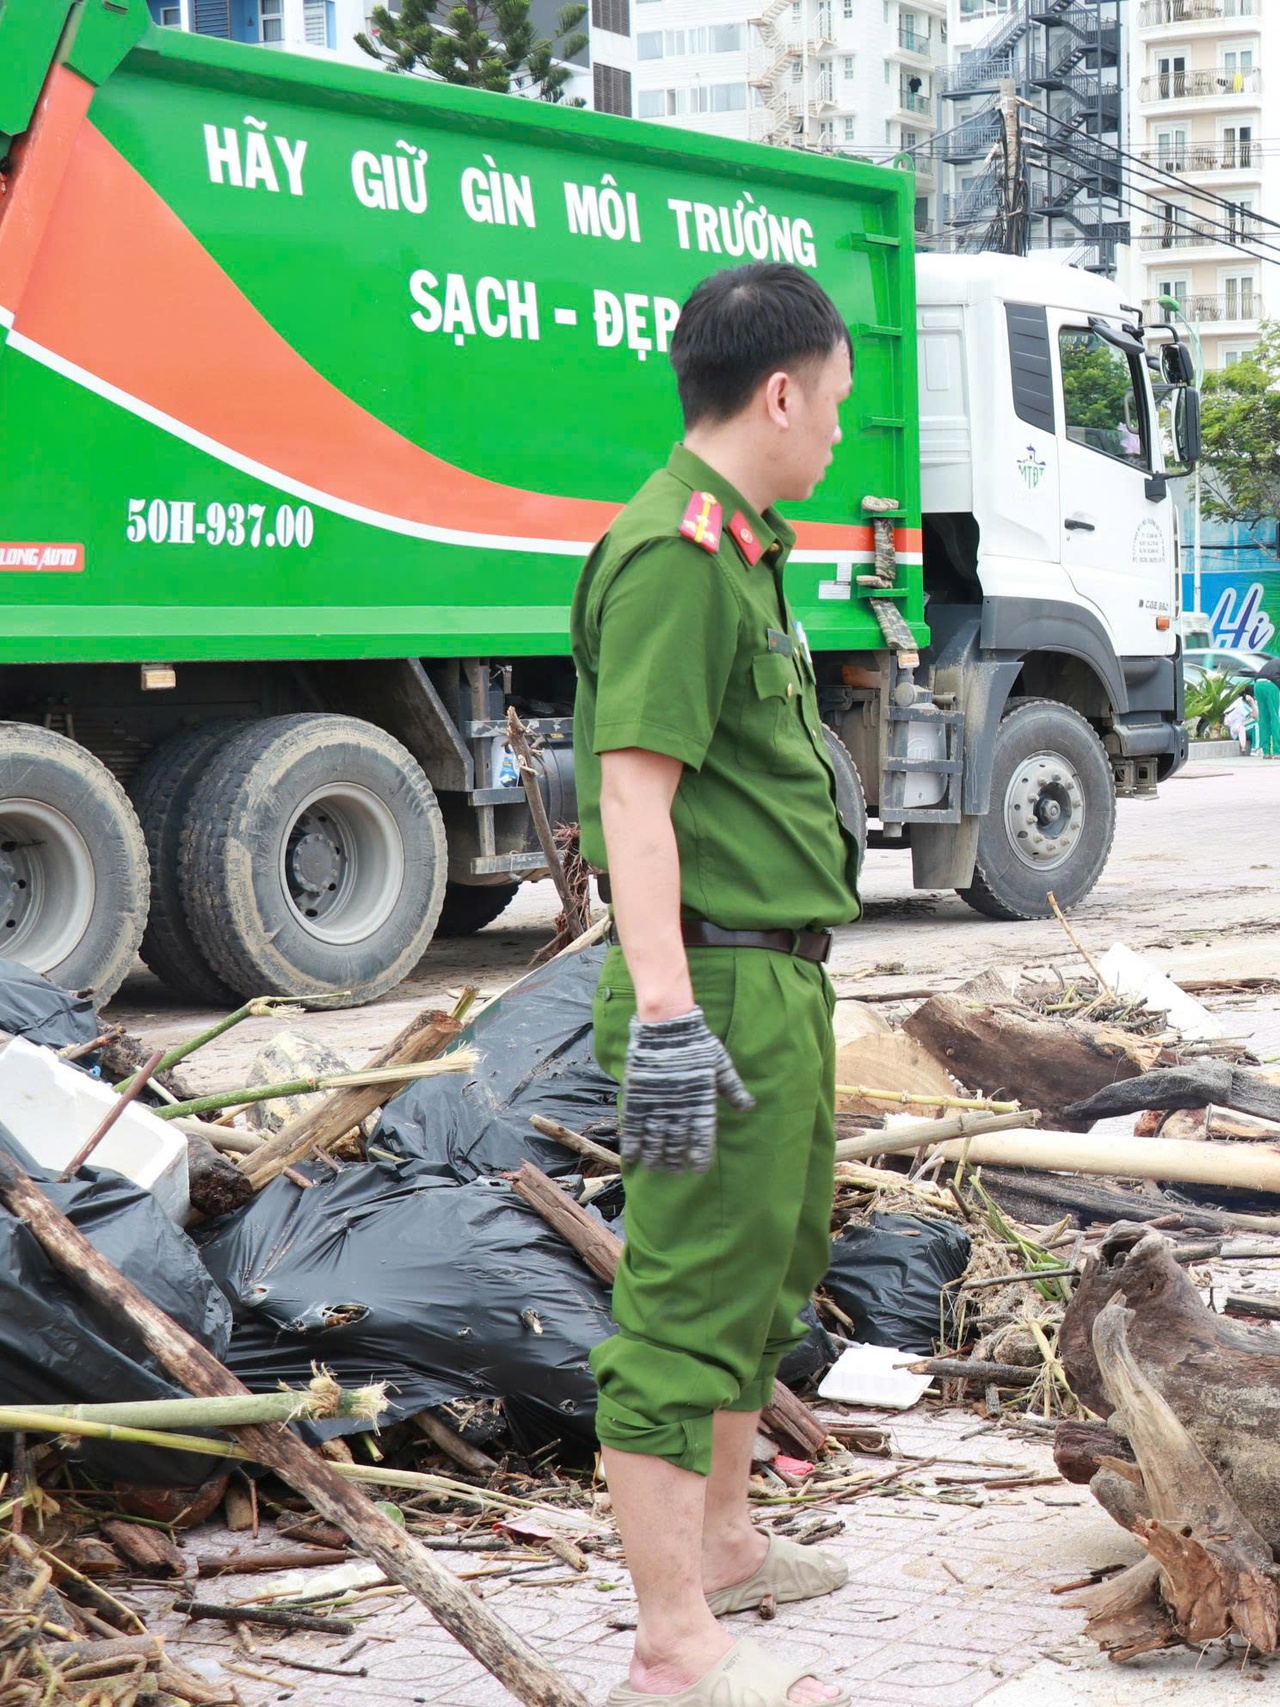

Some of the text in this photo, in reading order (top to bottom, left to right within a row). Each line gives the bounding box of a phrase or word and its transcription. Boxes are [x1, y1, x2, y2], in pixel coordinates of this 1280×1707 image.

[204, 115, 818, 267] HÃY GIỮ GÌN MÔI TRƯỜNG
[409, 269, 540, 346] SẠCH
[593, 288, 681, 362] ĐẸP
[126, 498, 315, 549] 50H-937.00
[36, 546, 77, 571] AUTO
[1211, 584, 1273, 650] Hi
